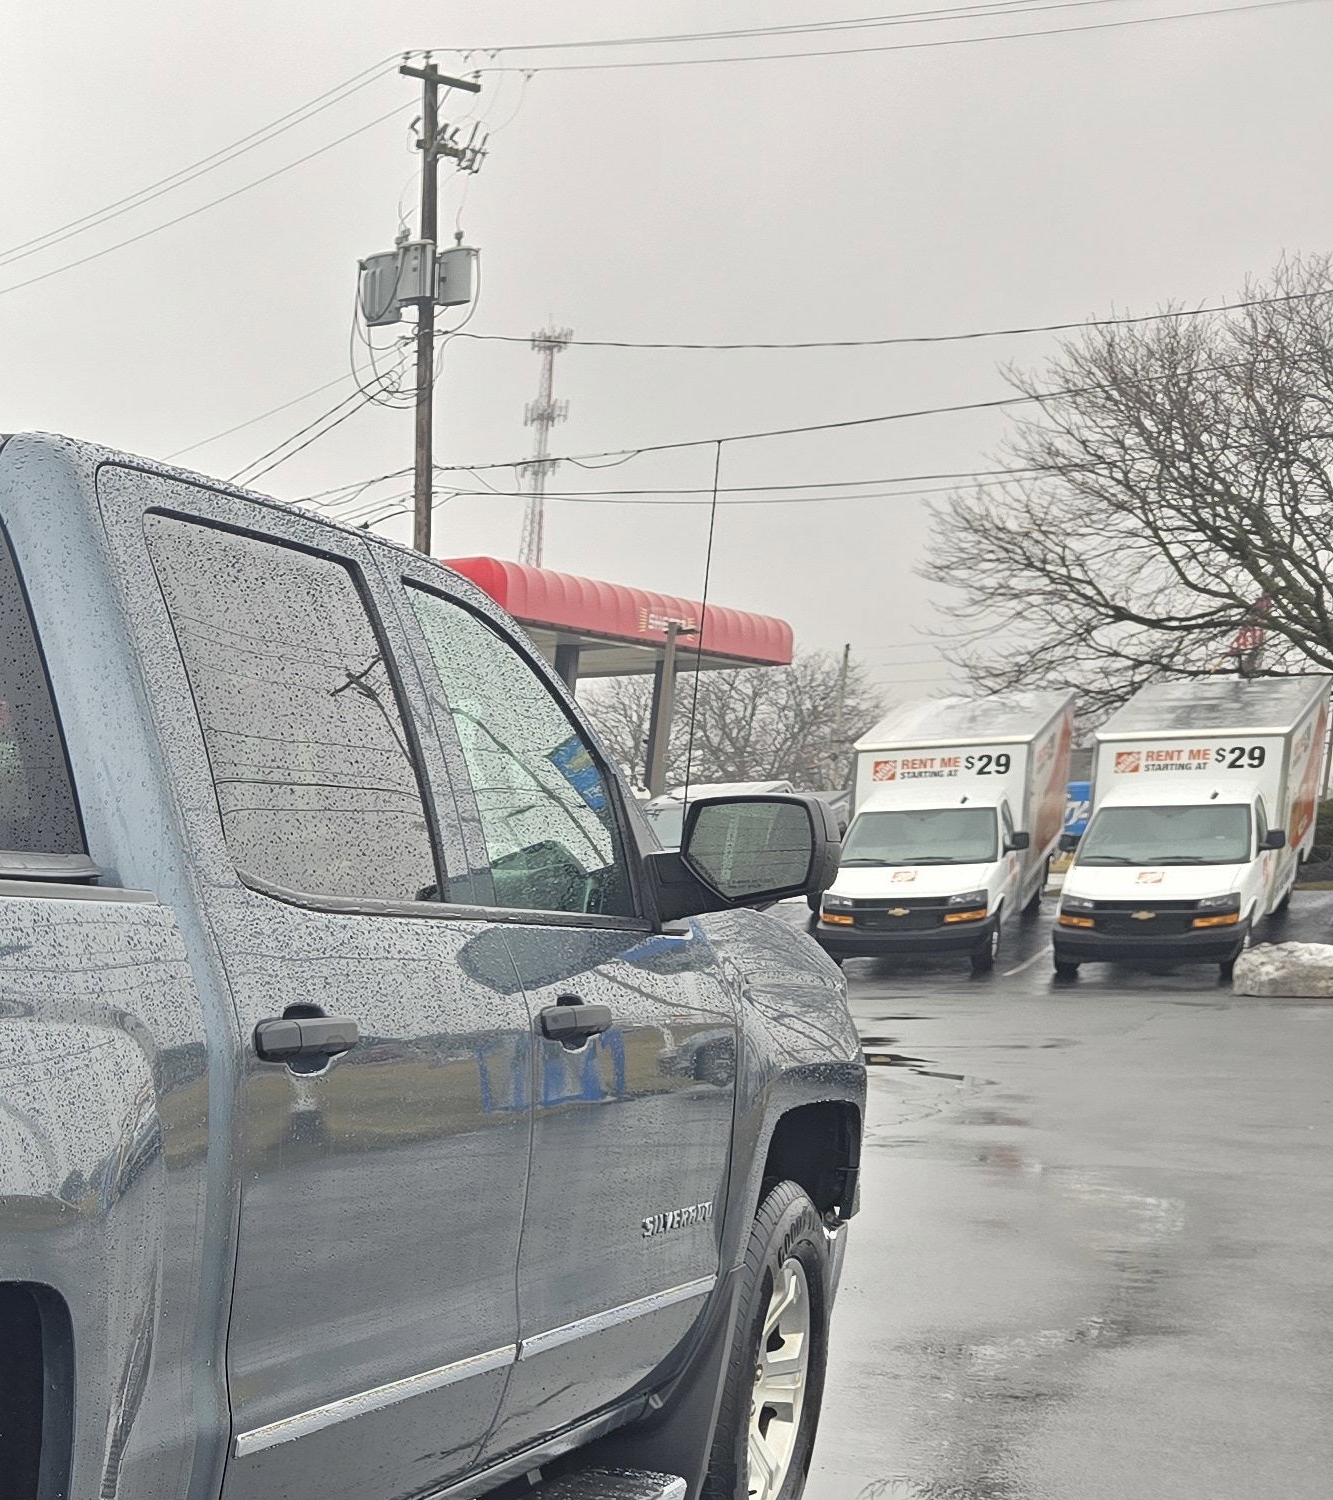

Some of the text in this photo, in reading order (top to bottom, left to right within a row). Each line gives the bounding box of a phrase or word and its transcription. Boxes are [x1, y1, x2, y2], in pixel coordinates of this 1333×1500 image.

[1145, 749, 1211, 762] RENT ME
[1214, 746, 1266, 769] $29
[900, 757, 961, 770] RENT ME
[964, 753, 1011, 775] $29
[1144, 762, 1209, 772] STARTING AT
[900, 770, 944, 780] STARTING
[946, 769, 959, 777] AT
[641, 1201, 713, 1238] SILVERADO
